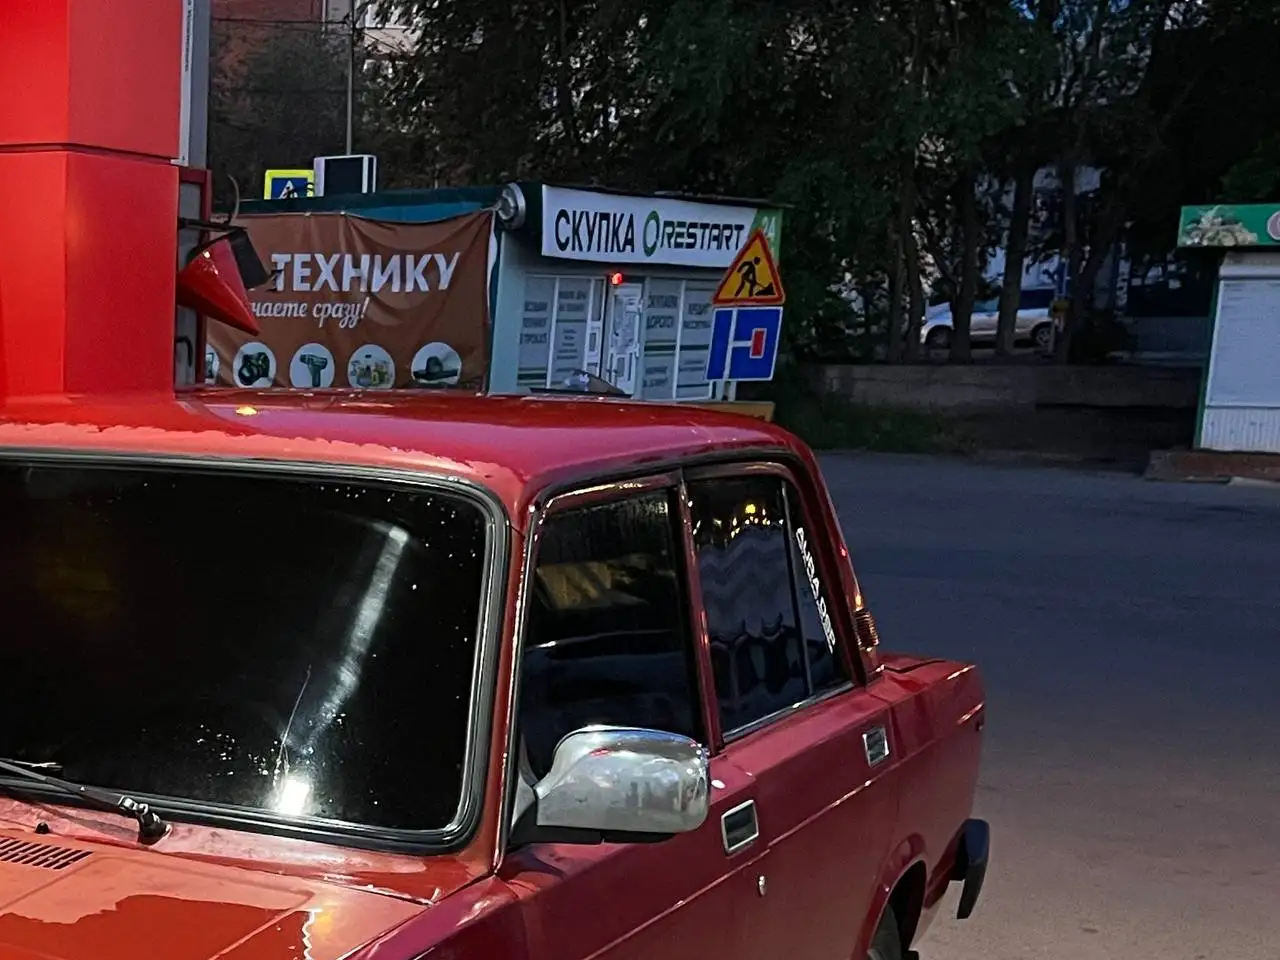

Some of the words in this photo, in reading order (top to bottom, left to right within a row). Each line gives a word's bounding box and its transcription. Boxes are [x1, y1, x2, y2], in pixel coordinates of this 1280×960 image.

[554, 208, 635, 253] СКУПКА
[271, 251, 461, 293] ТЕХНИКУ
[250, 302, 308, 318] чаете
[312, 297, 370, 329] сразу!
